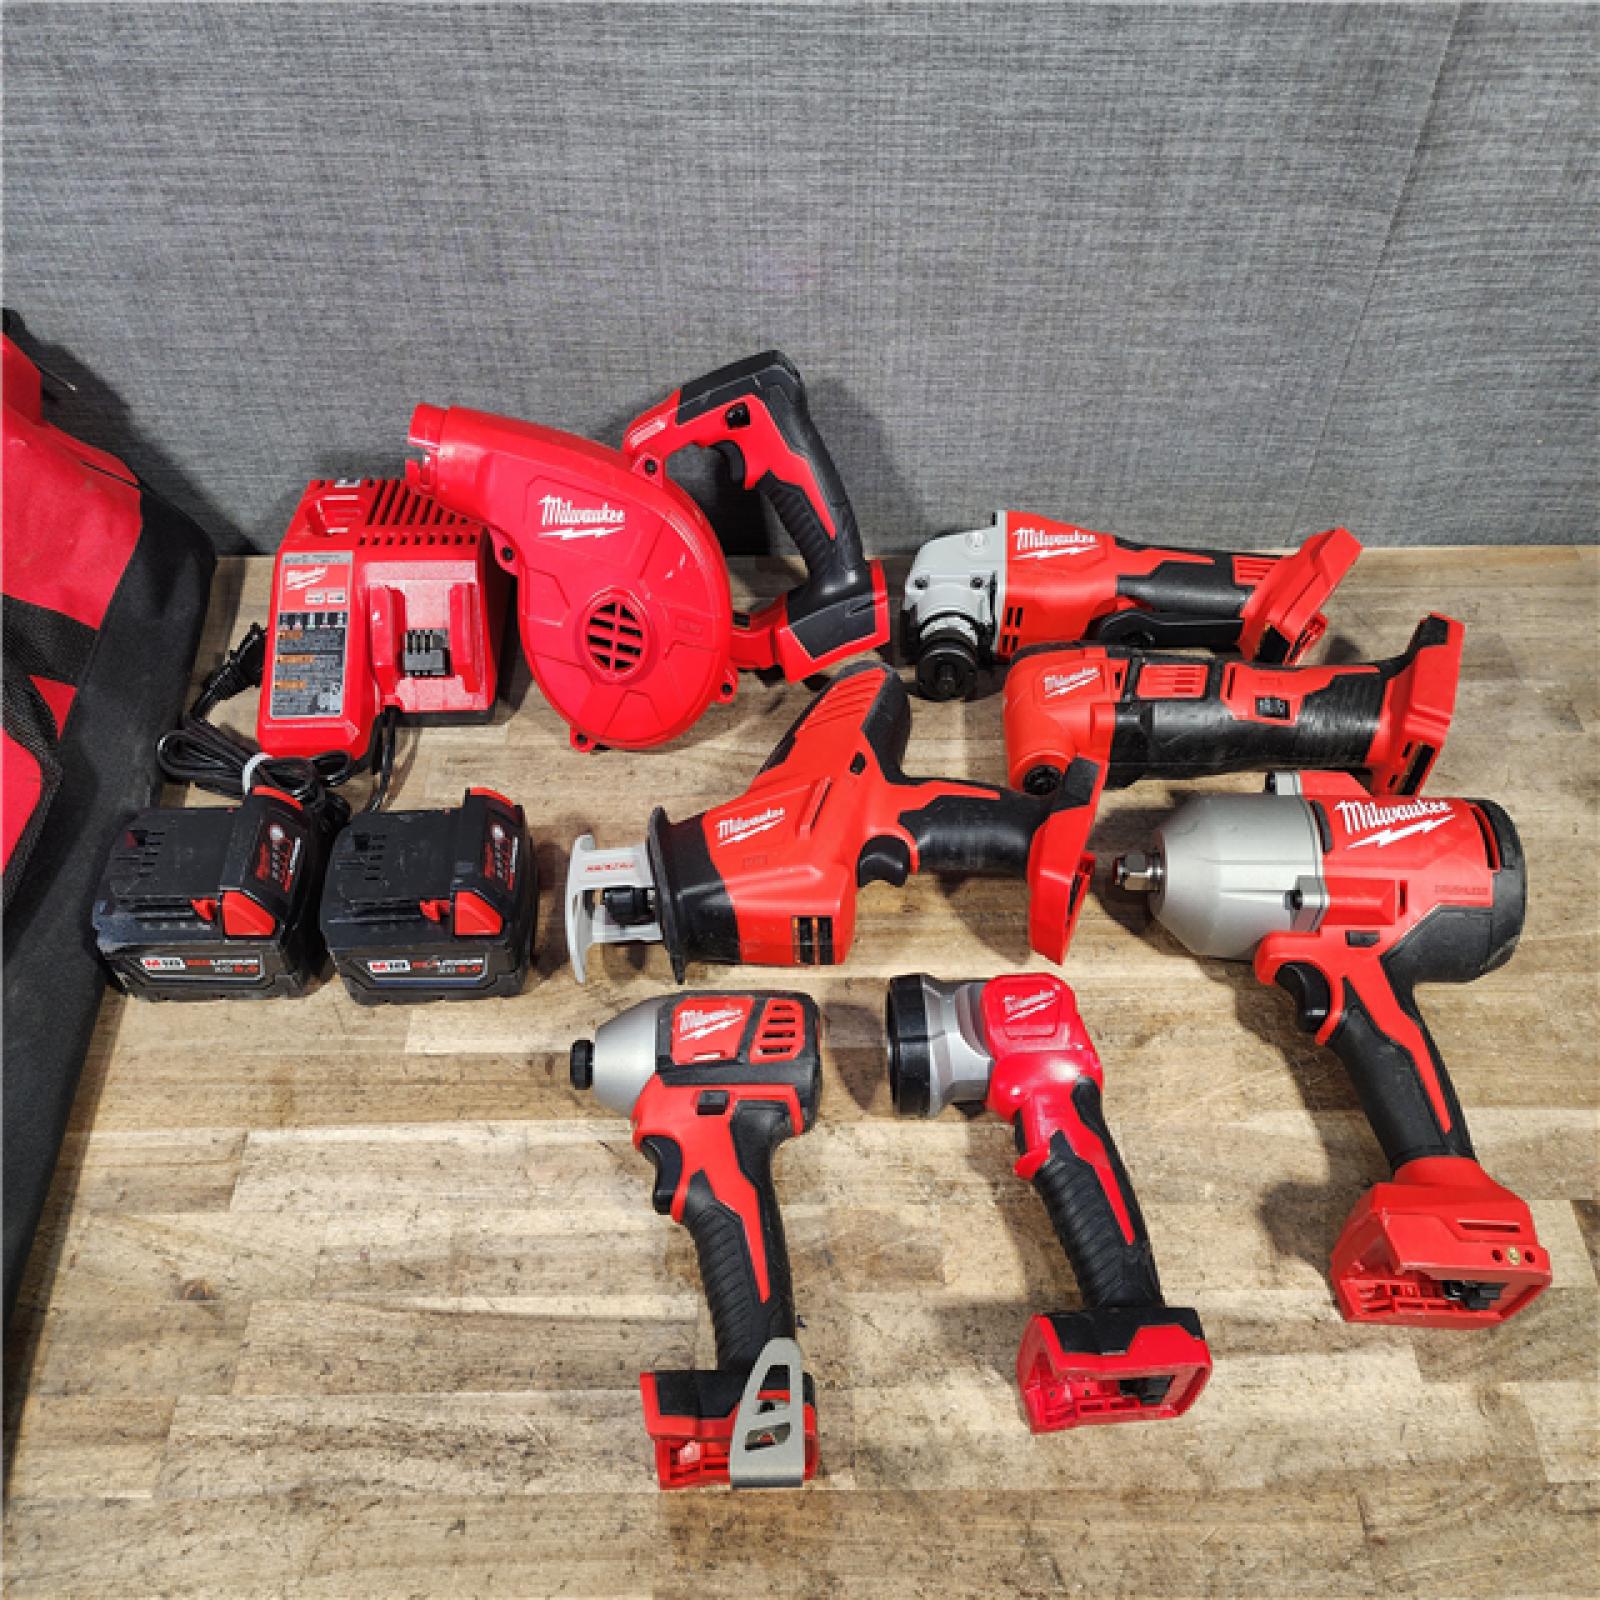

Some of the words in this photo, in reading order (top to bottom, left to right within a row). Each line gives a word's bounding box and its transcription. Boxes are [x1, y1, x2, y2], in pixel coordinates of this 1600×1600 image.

[537, 494, 625, 526] Milwaukee
[1012, 526, 1097, 551] Milwaukee
[714, 807, 786, 838] Milwaukee
[1334, 799, 1454, 835] Milwaukee
